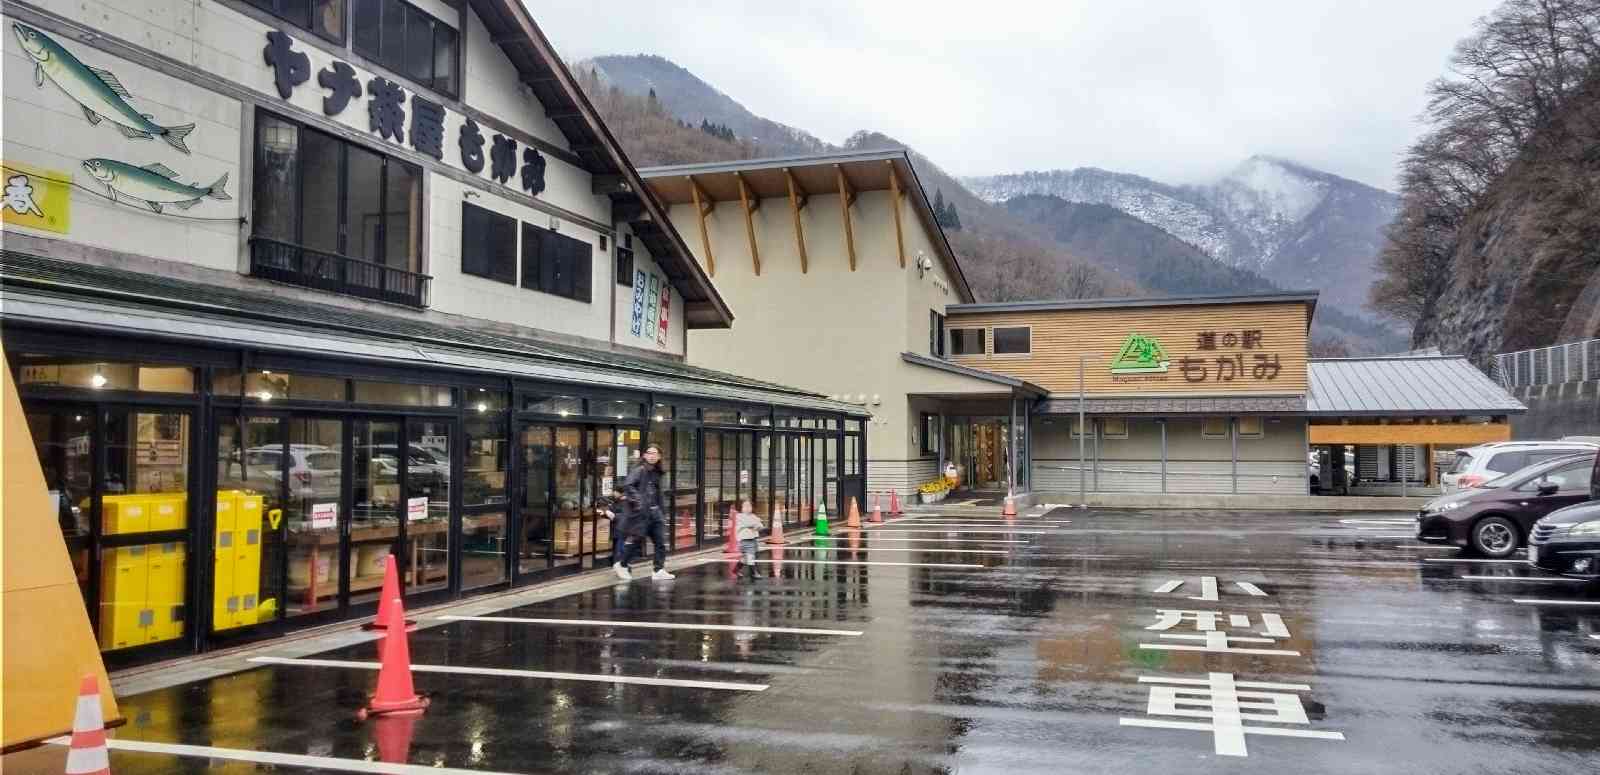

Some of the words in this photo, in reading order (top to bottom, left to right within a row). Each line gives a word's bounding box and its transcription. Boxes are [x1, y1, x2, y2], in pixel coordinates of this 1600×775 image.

[264, 30, 447, 161] ヤナ茶屋
[459, 117, 546, 196] もがみ
[1178, 352, 1282, 383] もがみ
[1196, 330, 1264, 351] 道の駅
[1119, 576, 1346, 757] 小型車
